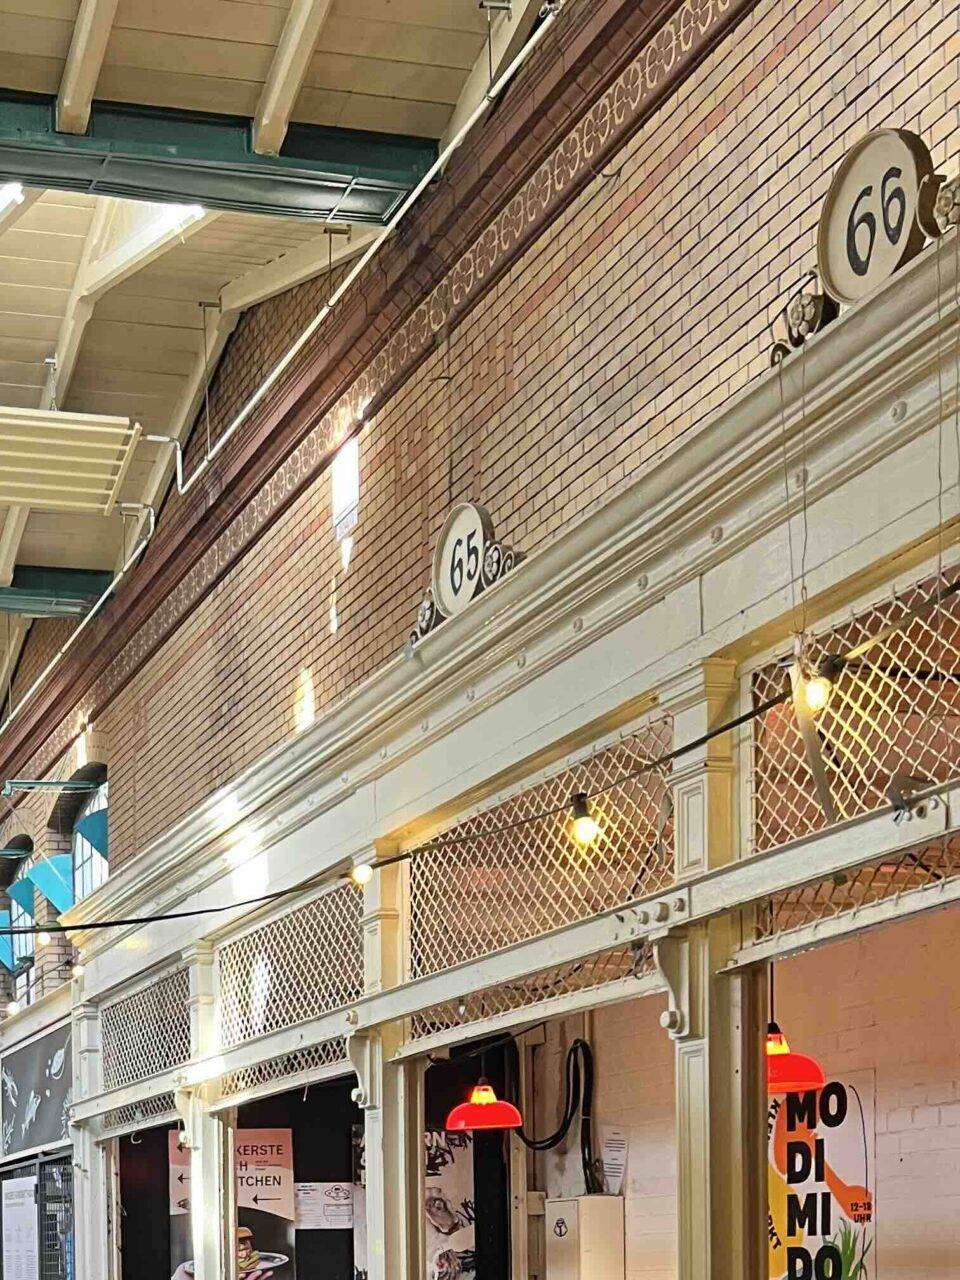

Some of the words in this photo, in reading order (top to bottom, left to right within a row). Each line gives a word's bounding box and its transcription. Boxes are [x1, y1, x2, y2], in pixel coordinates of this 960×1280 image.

[846, 167, 907, 277] 66
[449, 529, 479, 597] 65
[786, 1081, 848, 1132] MO
[237, 1144, 284, 1157] KERSTE
[787, 1138, 825, 1185] DI
[238, 1175, 283, 1188] TCHEN
[787, 1192, 831, 1238] MI
[853, 1213, 872, 1224] UHR
